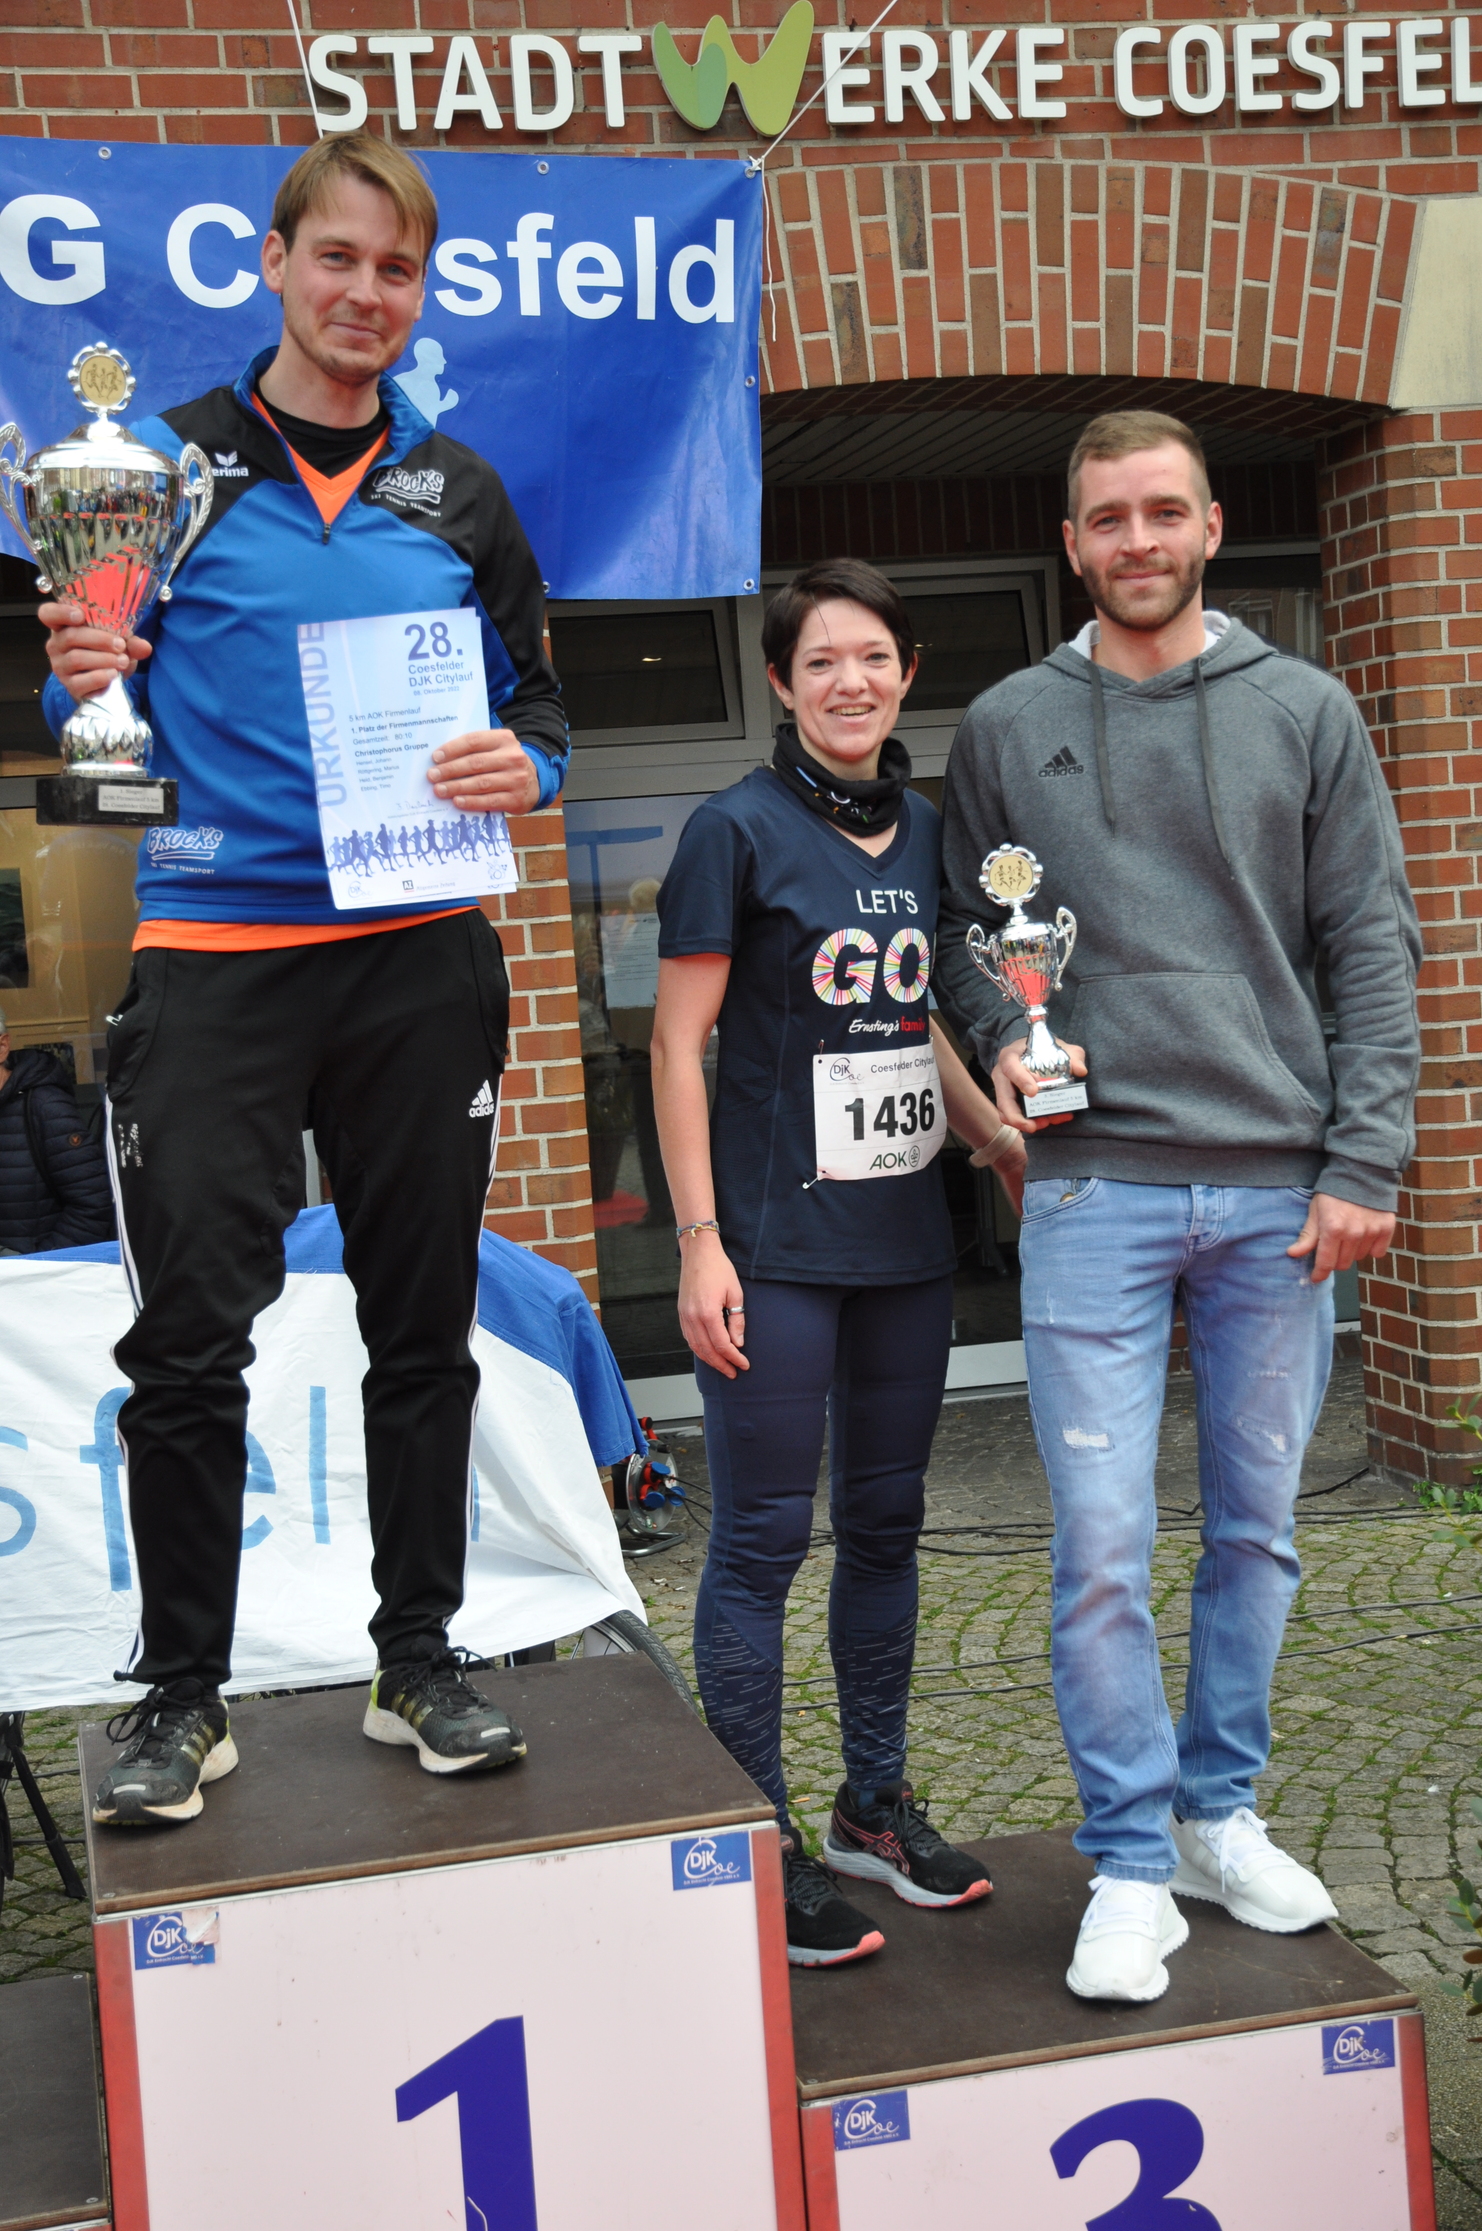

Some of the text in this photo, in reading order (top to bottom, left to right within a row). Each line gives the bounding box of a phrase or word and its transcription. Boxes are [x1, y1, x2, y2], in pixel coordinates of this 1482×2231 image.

[0, 194, 735, 324] G Csfeld
[212, 466, 249, 477] erima
[404, 621, 463, 661] 28.
[408, 661, 464, 675] Coesfelder
[409, 671, 473, 687] DJK Citylauf
[298, 622, 347, 808] URKUNDE
[367, 711, 384, 720] AOK
[385, 706, 421, 718] Firmenlauf
[389, 715, 459, 729] Firmenmannschaften
[354, 743, 429, 758] Christophorus Gruppe
[1038, 764, 1084, 778] adidas
[160, 863, 177, 871] TENNIS
[179, 865, 215, 875] TEAMSPORT
[856, 889, 919, 914] LET'S
[812, 927, 930, 1006] GO
[849, 1016, 926, 1037] Ernsting's family
[870, 1060, 913, 1074] Coesfeder
[869, 1151, 907, 1171] AOK
[396, 2015, 537, 2231] 1
[1050, 2098, 1223, 2231] 3
